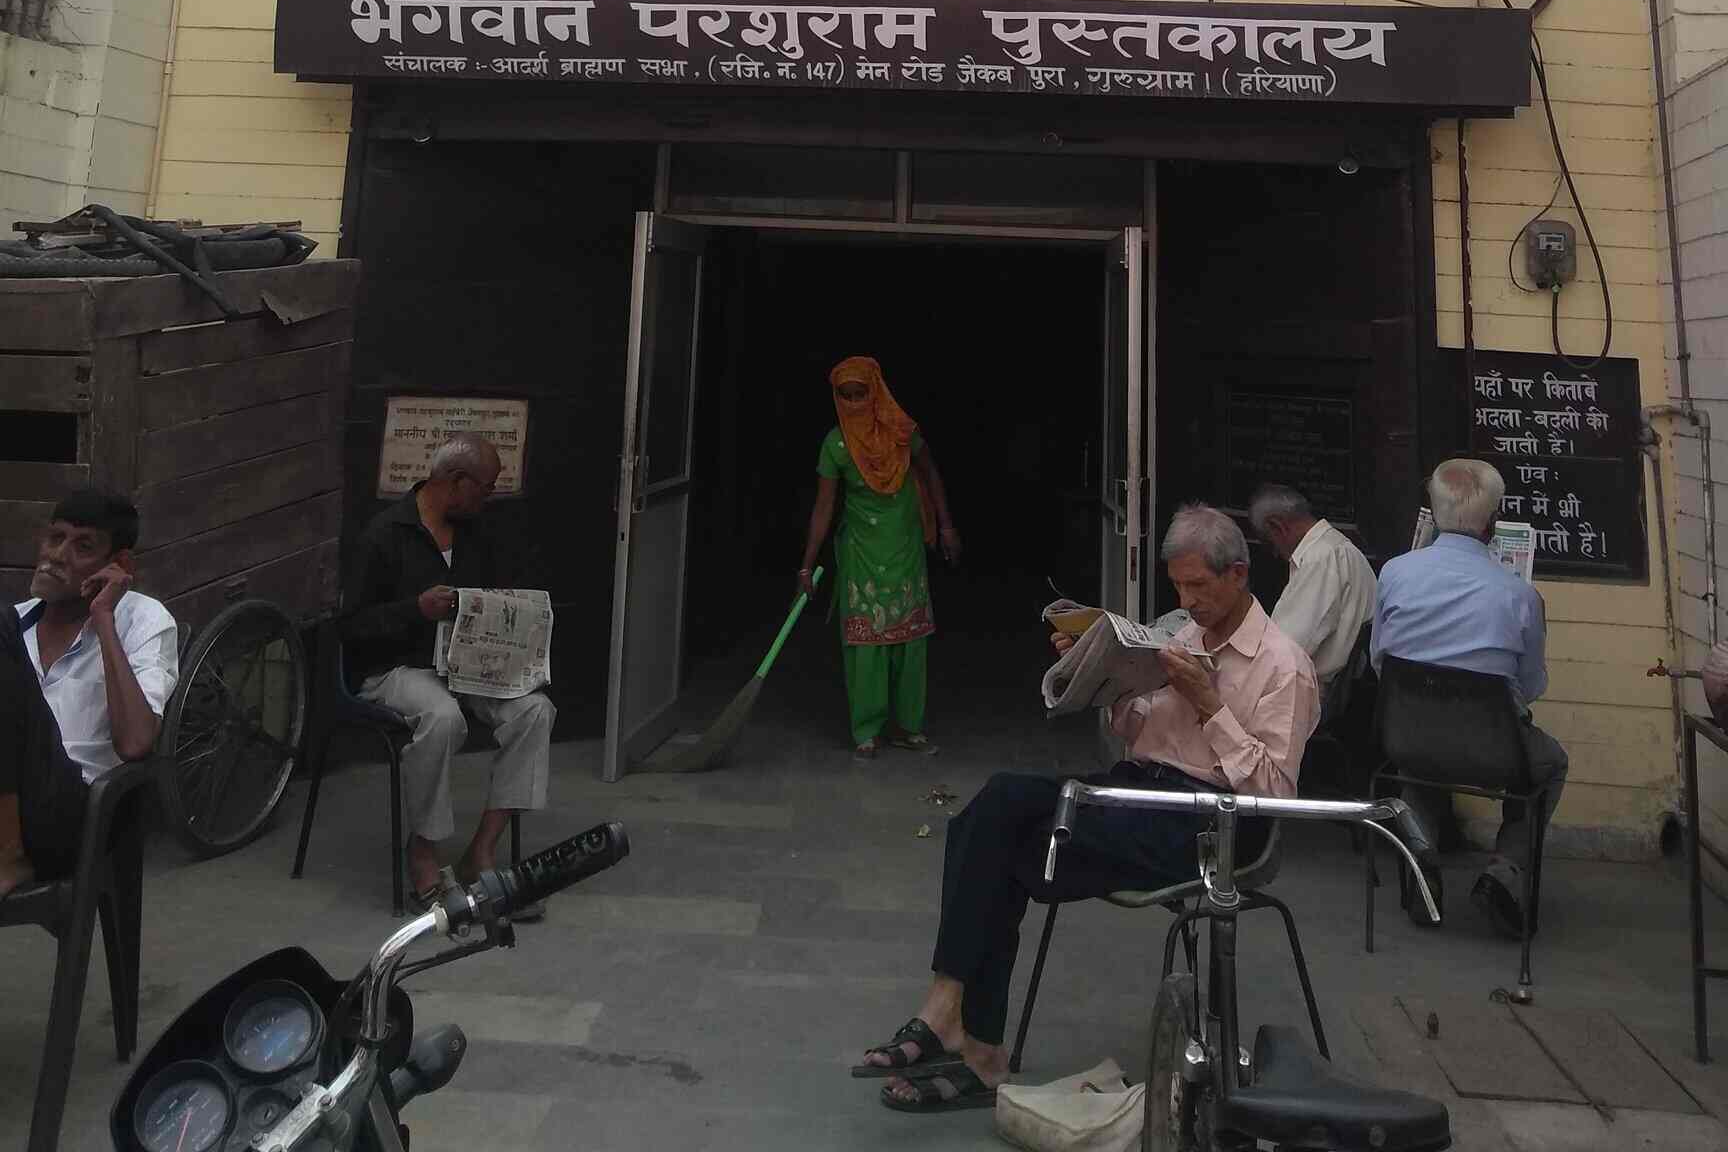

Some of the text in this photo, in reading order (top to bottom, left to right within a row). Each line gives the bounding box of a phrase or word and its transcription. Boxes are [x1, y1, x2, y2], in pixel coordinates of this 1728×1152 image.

[630, 2, 936, 61] परशुराम
[982, 10, 1397, 66] पुस्तकालय
[559, 56, 627, 79] ब्राह्मण
[856, 56, 890, 82] मेन
[956, 55, 1015, 86] जैकब
[1508, 377, 1535, 400] पर
[1542, 371, 1599, 402] किताबें
[1585, 406, 1609, 432] की
[1494, 431, 1539, 456] जाती
[1531, 490, 1551, 517] में
[1558, 491, 1584, 519] भी
